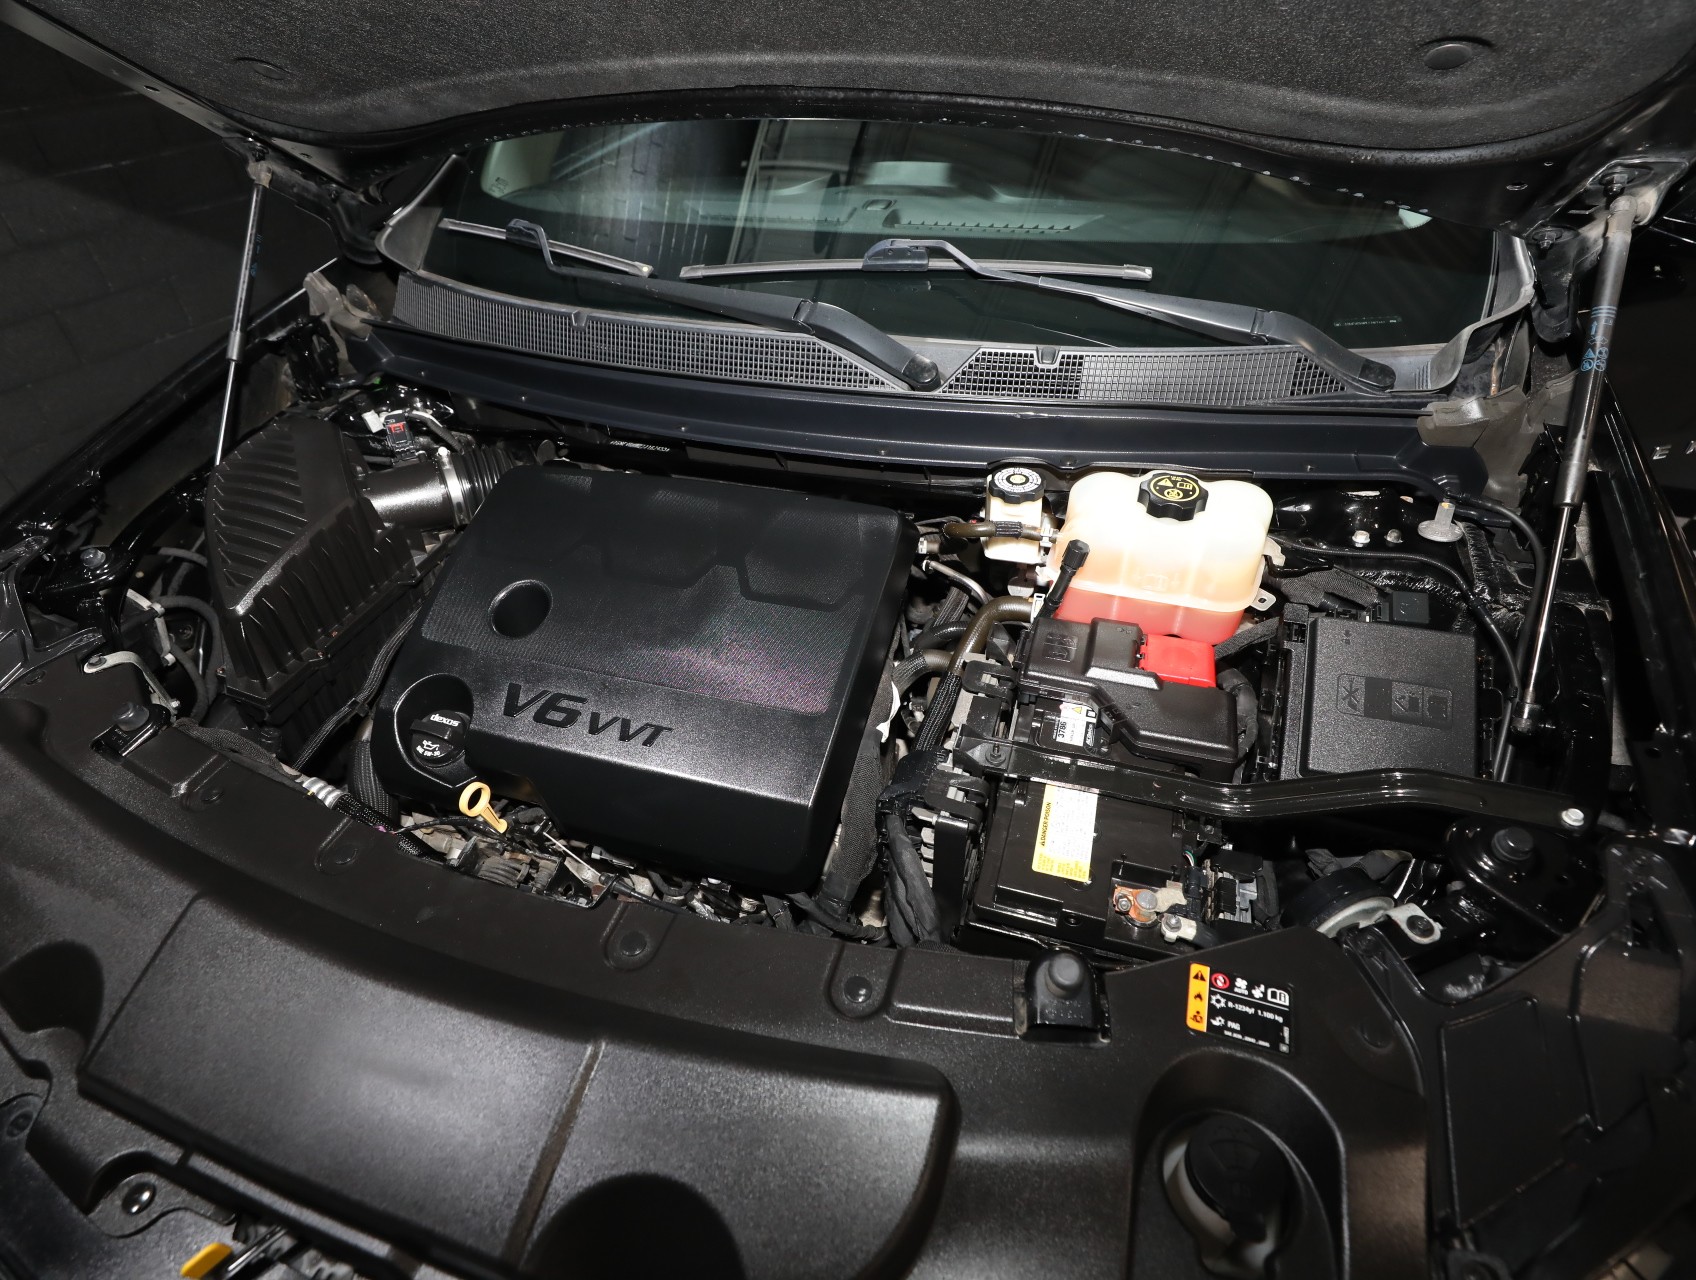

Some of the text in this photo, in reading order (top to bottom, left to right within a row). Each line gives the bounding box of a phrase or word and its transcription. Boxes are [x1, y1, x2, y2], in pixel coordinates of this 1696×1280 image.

[430, 713, 461, 727] dexos
[503, 682, 674, 748] V6 VVT
[1058, 721, 1067, 739] 3786
[1040, 802, 1052, 841] DANGER POISON
[1257, 1009, 1275, 1020] 1.100
[1274, 1014, 1284, 1024] kg
